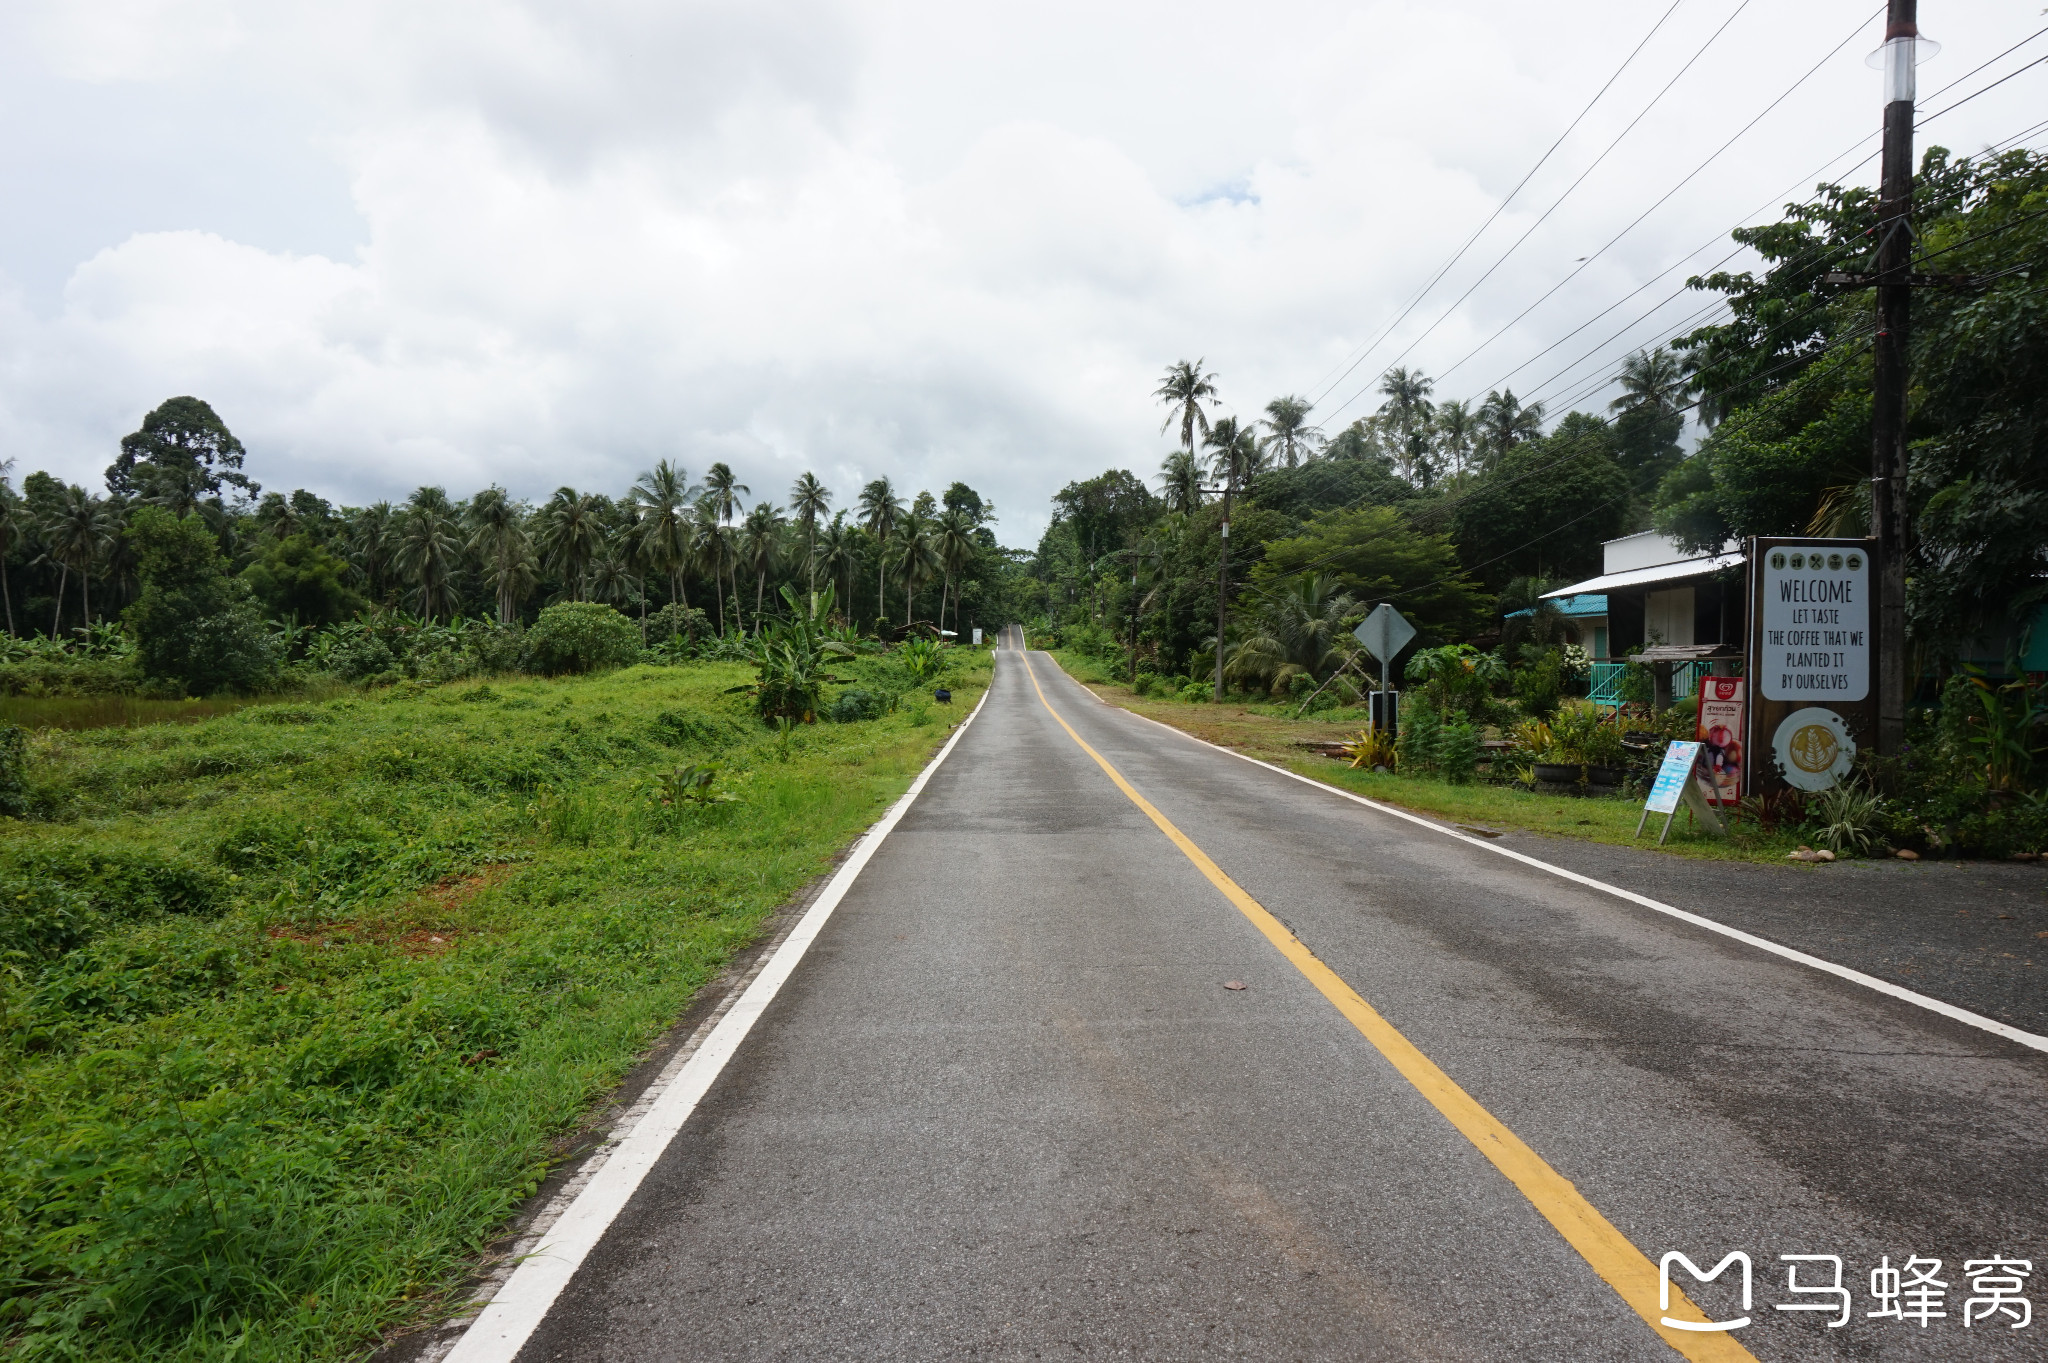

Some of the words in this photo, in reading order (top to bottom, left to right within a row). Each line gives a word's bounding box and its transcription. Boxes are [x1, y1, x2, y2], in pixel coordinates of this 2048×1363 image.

[1779, 578, 1853, 604] WELCOME
[1792, 608, 1809, 624] LET
[1811, 608, 1840, 625] TASTE
[1767, 630, 1785, 646] THE
[1787, 630, 1821, 646] COFFEE
[1823, 630, 1847, 646] THAT
[1849, 630, 1864, 647] WE
[1786, 652, 1830, 668] PLANTED
[1832, 652, 1845, 668] IT
[1781, 673, 1794, 689] BY
[1796, 673, 1849, 690] OURSELVES
